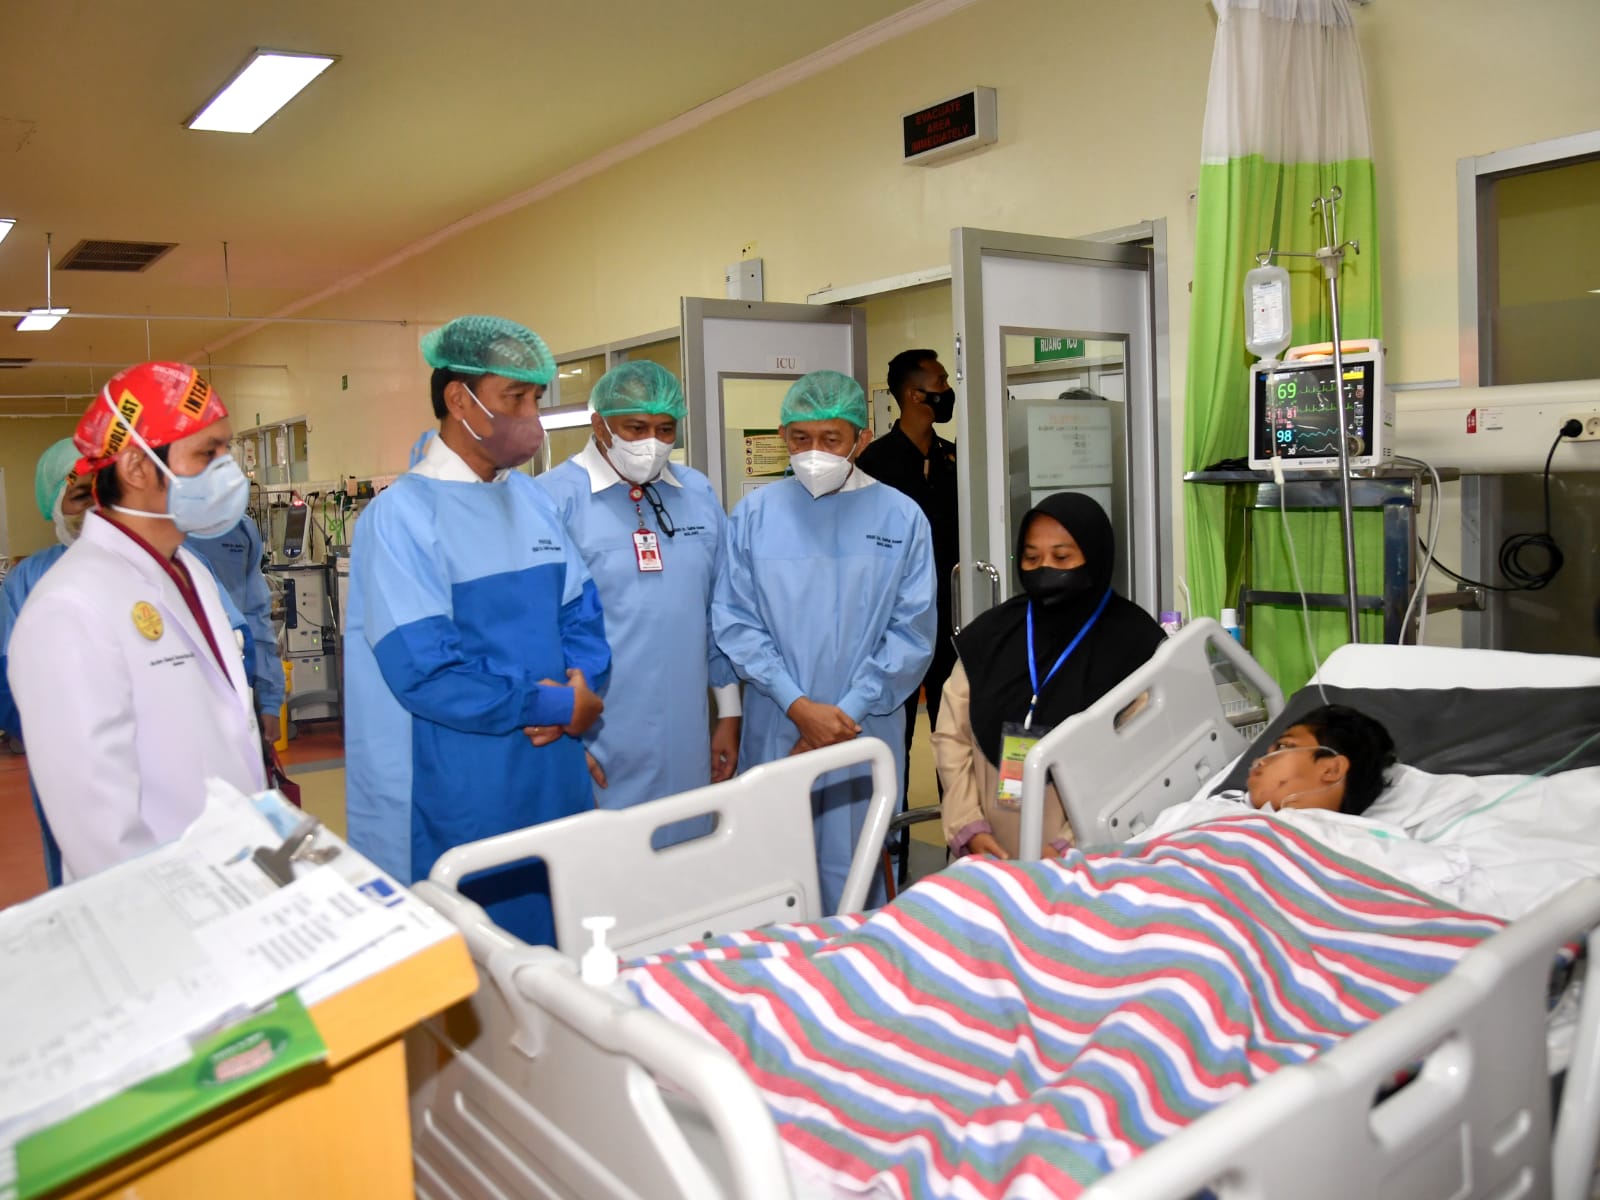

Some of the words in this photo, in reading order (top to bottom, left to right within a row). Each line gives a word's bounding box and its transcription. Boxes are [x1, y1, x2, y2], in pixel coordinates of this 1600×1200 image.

[1040, 337, 1062, 352] RUANG
[776, 357, 796, 369] ICU
[1278, 383, 1296, 399] 69
[1277, 430, 1292, 443] 98
